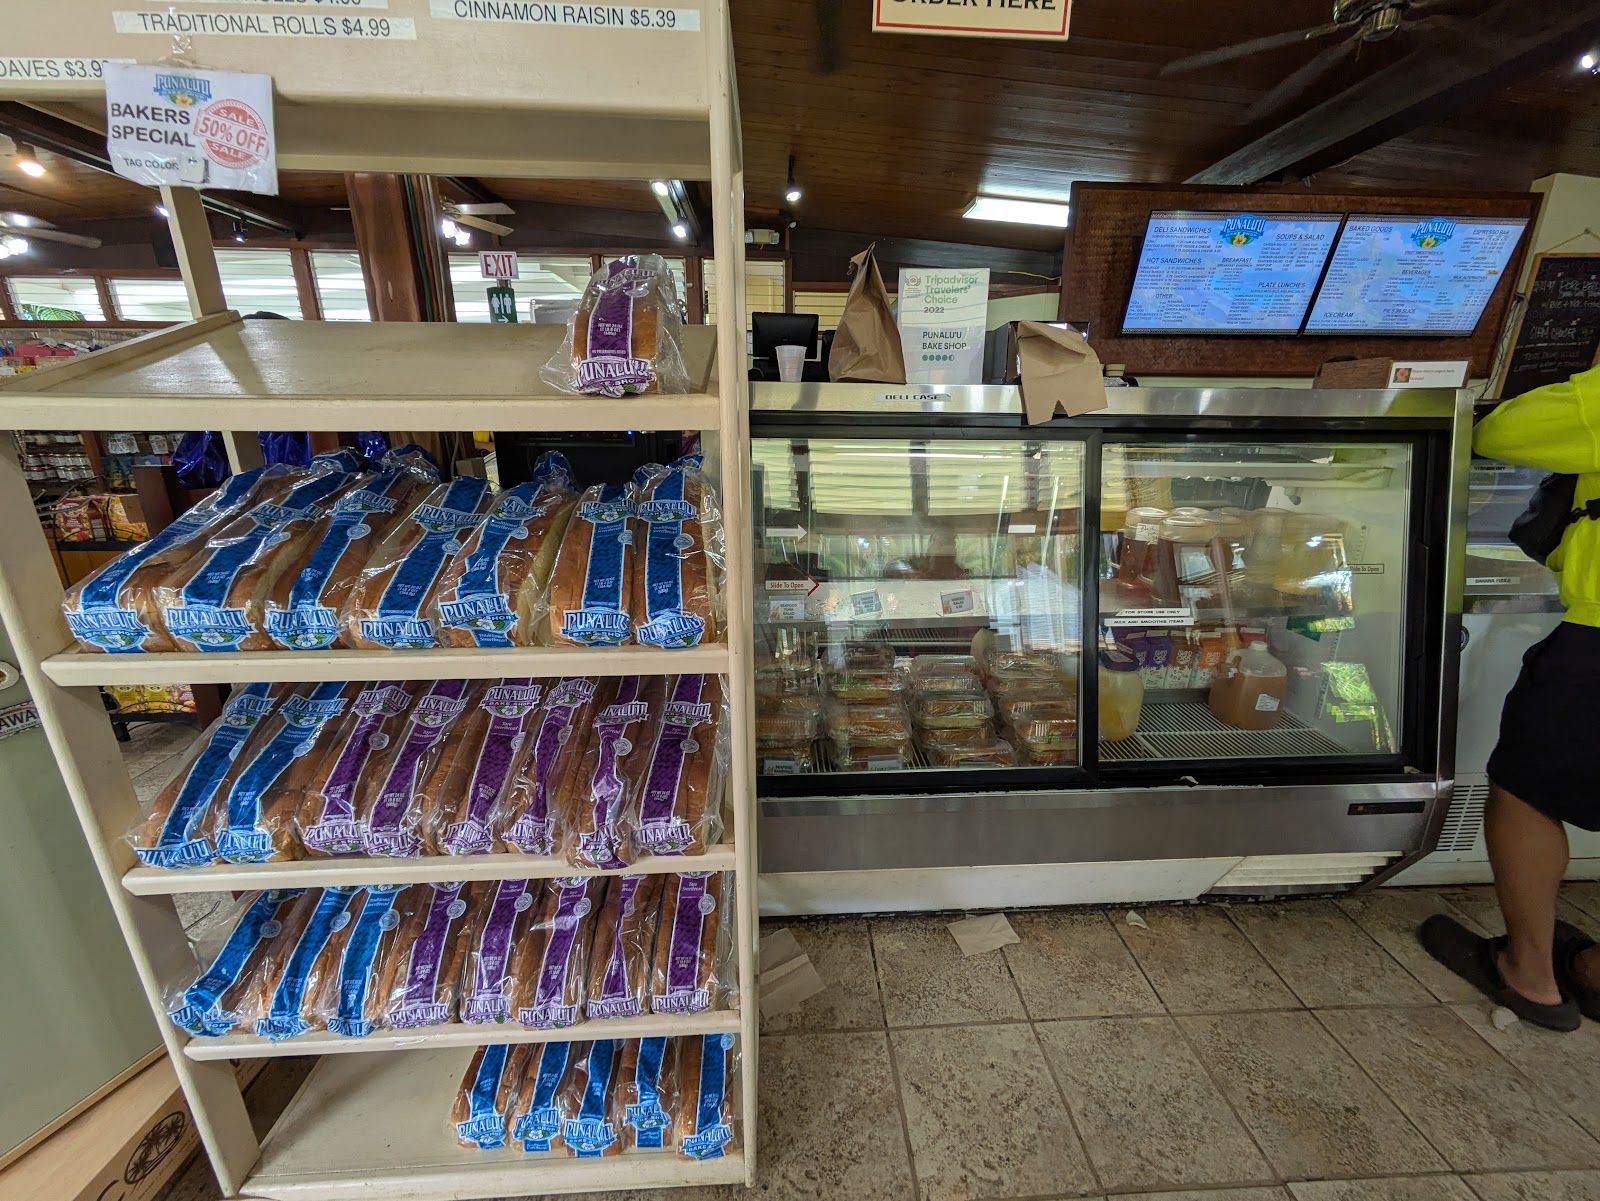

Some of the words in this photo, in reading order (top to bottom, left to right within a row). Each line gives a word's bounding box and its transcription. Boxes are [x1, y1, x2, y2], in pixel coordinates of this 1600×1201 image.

[454, 0, 557, 23] CINNAMON
[563, 7, 624, 25] RAISIN
[630, 10, 676, 28] $5.39
[137, 13, 268, 33] TRADITIONAL
[273, 16, 337, 35] ROLLS
[342, 18, 391, 37] $4.99
[65, 60, 108, 77] $3.9
[111, 103, 190, 125] BAKERS
[219, 109, 255, 127] SALE
[112, 125, 196, 148] SPECIAL
[199, 117, 233, 142] 50%
[236, 129, 266, 152] OFF
[210, 142, 245, 160] SALE
[124, 158, 142, 167] TAG
[145, 159, 179, 170] COLOR
[484, 254, 514, 277] EXIT
[925, 275, 978, 287] Tripadvisor
[924, 295, 958, 304] Choice
[922, 331, 962, 339] PUNALU'U
[922, 342, 943, 350] BAKE
[944, 342, 967, 350] SHOP
